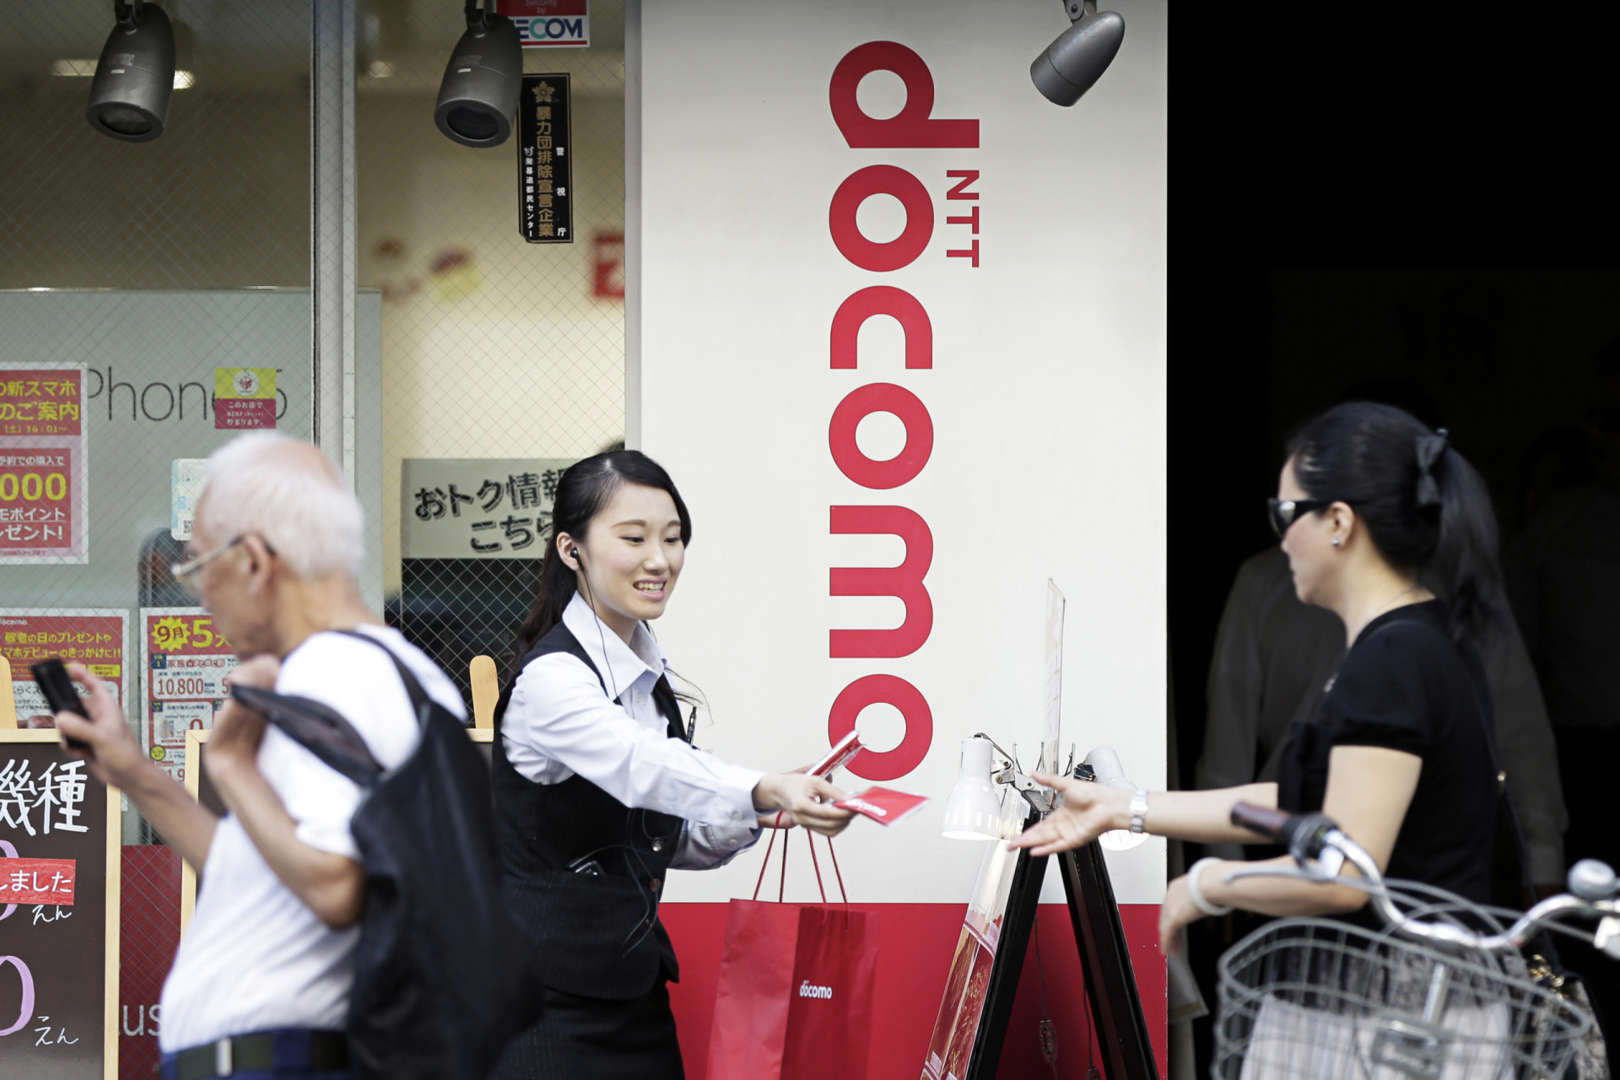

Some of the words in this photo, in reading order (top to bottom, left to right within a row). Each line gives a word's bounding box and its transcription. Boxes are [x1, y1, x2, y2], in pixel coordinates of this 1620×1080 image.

[515, 18, 582, 39] ECOM
[946, 169, 979, 268] NTT
[829, 40, 979, 782] docomo
[158, 678, 204, 696] 10,800
[801, 983, 833, 1000] docomo
[34, 1015, 80, 1047] えん
